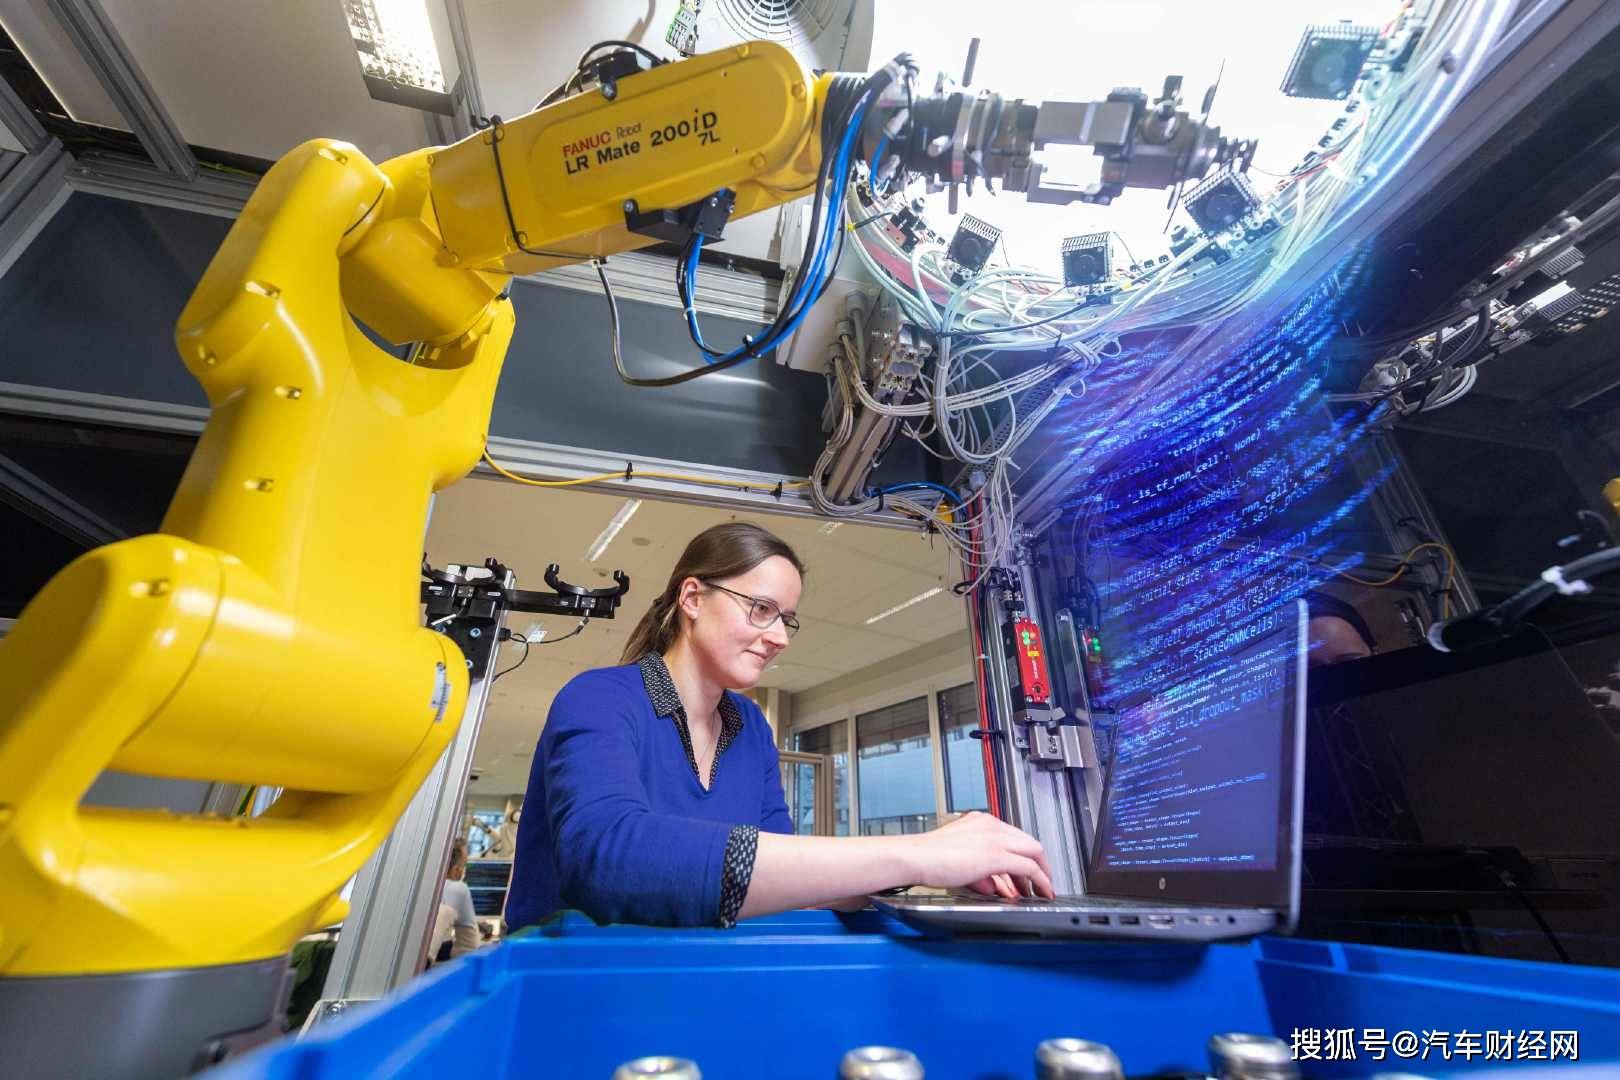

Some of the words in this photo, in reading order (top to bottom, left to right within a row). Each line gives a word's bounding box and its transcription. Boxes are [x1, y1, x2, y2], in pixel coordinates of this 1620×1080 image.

[562, 131, 612, 157] FANUC
[698, 132, 721, 146] 7L
[565, 155, 590, 175] LR
[597, 141, 641, 165] Mate
